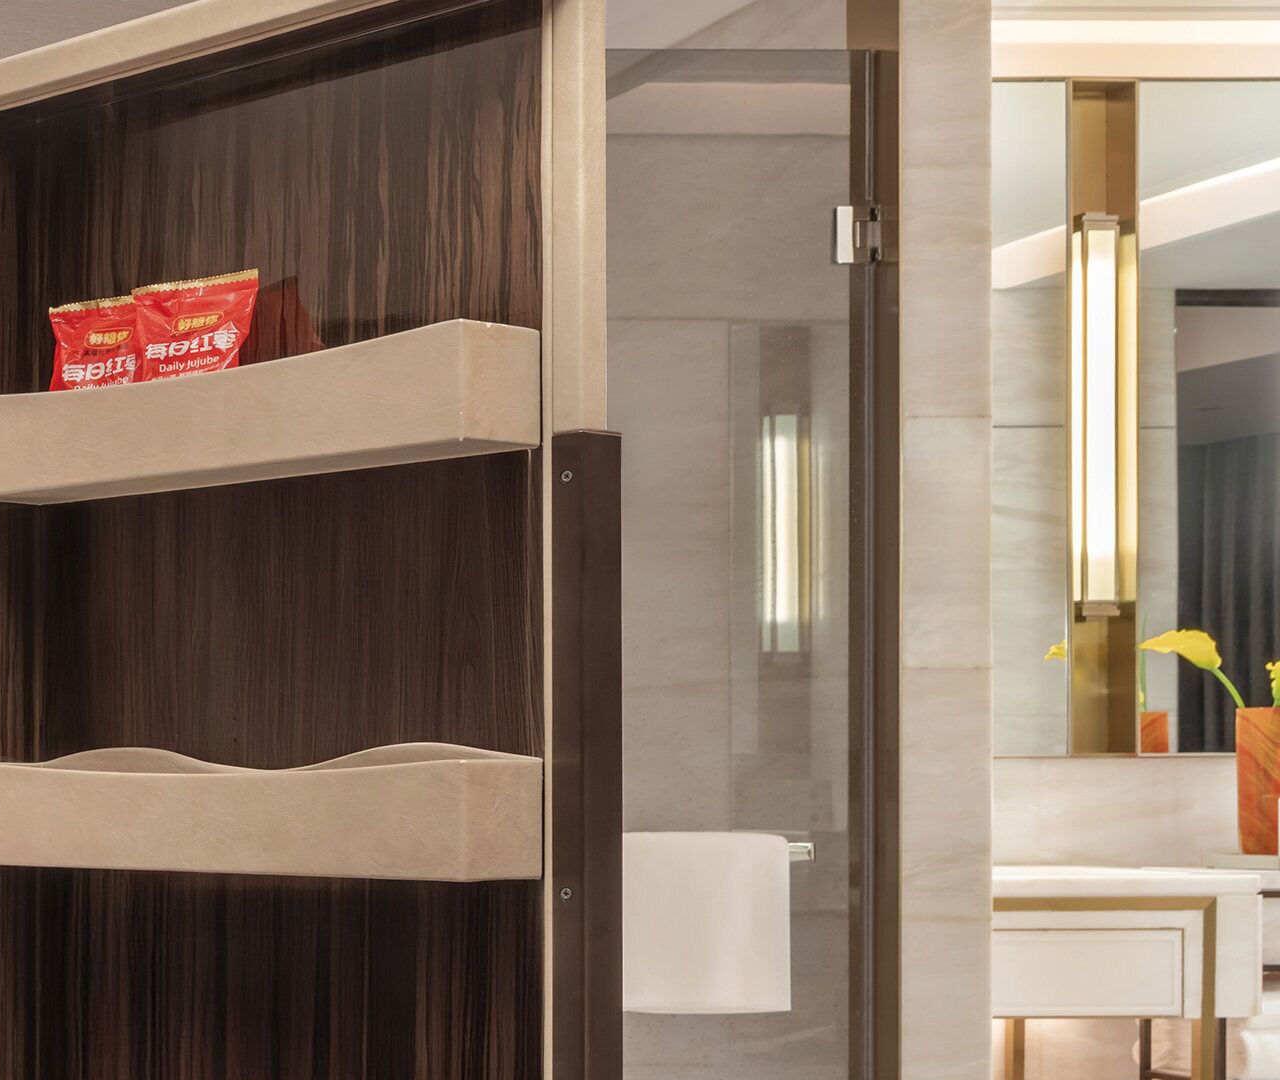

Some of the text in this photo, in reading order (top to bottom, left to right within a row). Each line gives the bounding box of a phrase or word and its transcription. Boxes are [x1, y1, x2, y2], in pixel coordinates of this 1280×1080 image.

[177, 313, 219, 332] 好想你
[158, 361, 186, 373] Daily
[186, 355, 220, 370] Jujube
